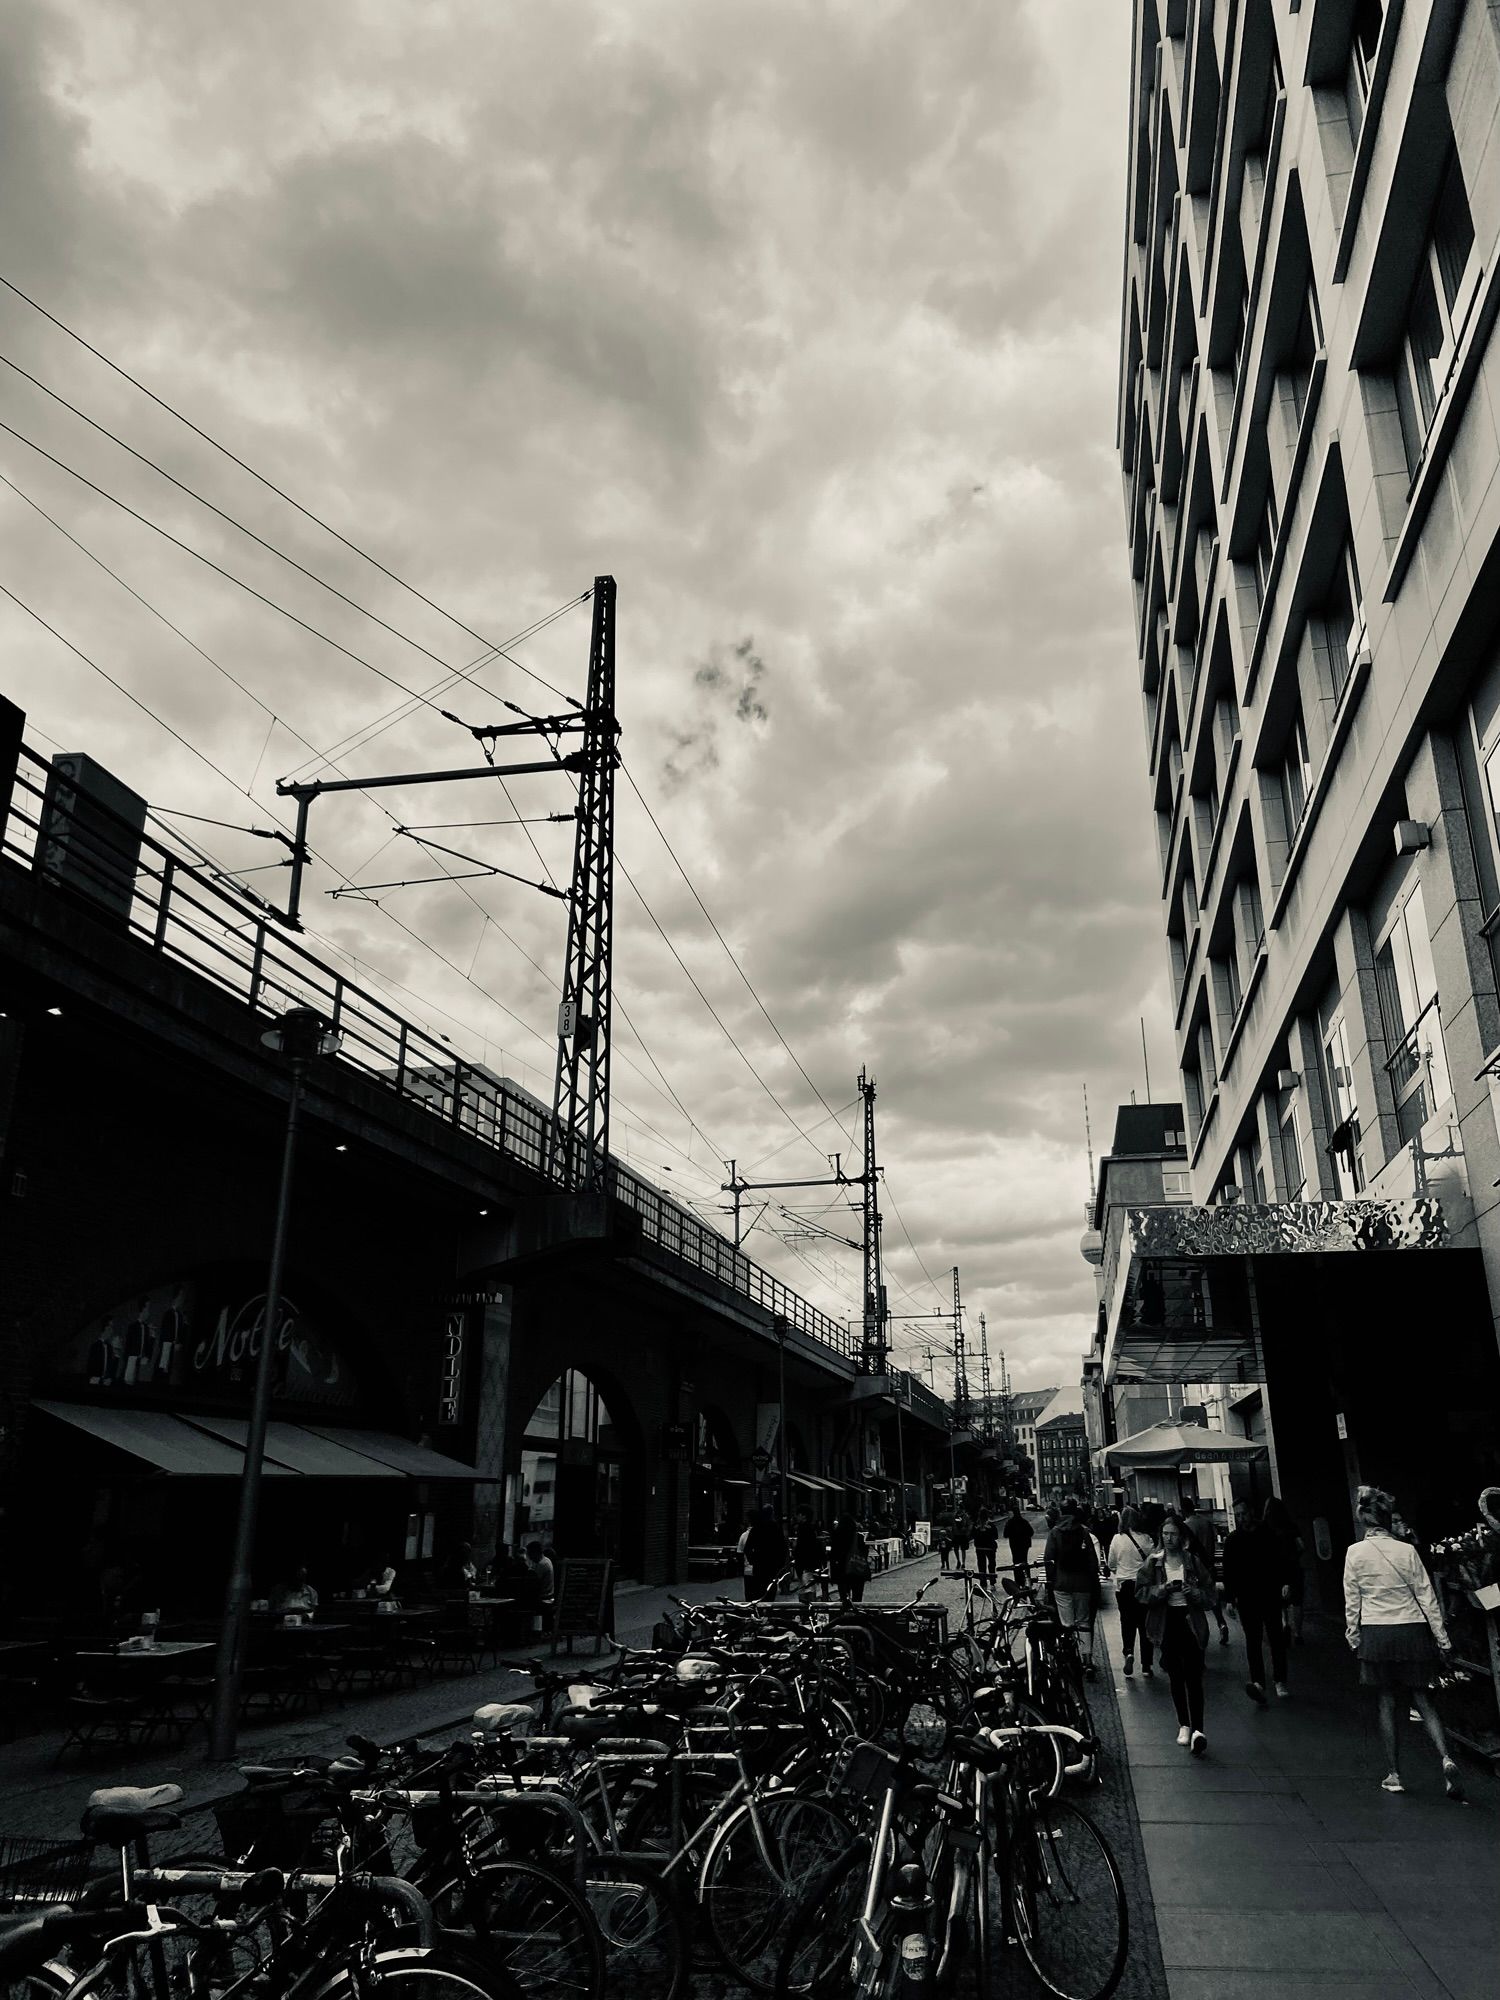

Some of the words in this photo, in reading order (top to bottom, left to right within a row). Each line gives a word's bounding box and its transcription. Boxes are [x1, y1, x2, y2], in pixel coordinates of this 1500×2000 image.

[564, 1005, 571, 1017] 3
[563, 1019, 570, 1031] 8
[441, 1314, 464, 1422] NOLLE
